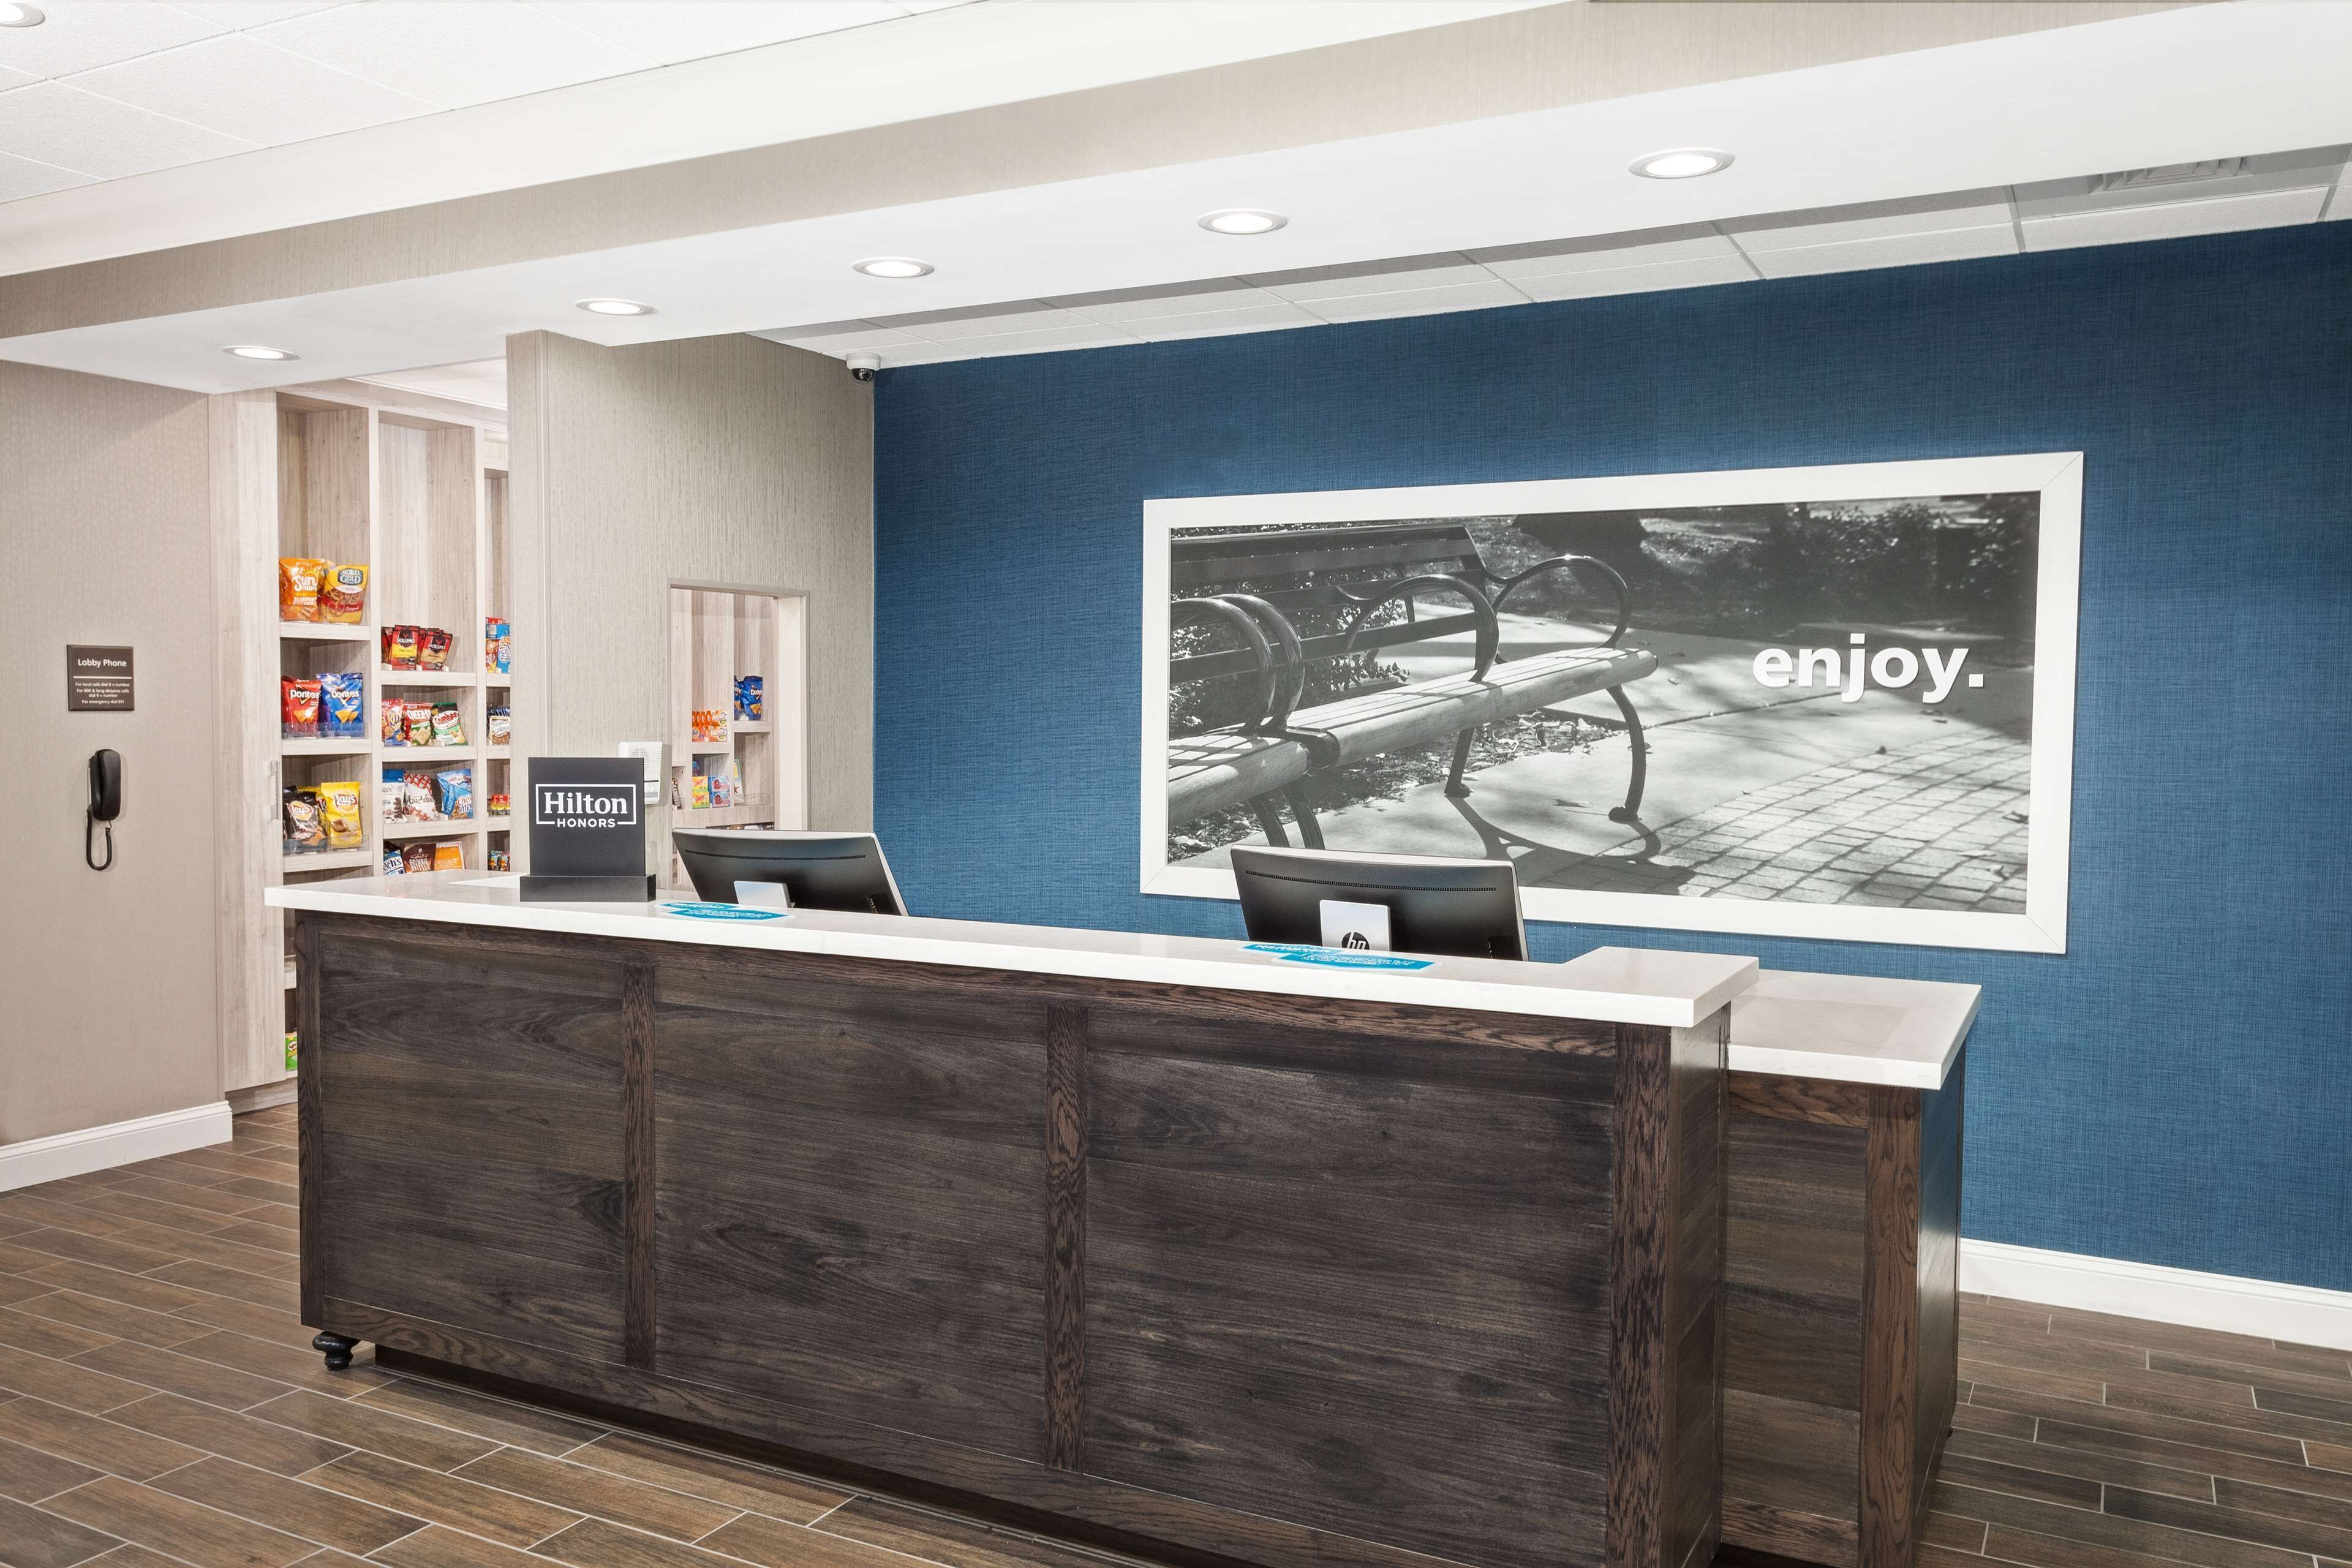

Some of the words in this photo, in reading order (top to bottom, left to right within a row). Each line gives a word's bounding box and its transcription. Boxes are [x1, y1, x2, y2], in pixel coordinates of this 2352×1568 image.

[292, 575, 318, 592] Sun
[78, 658, 101, 668] Lobby
[1753, 633, 1984, 704] enjoy.
[290, 690, 320, 699] Doritos
[437, 712, 459, 724] Combos
[335, 793, 356, 805] Lay's
[544, 792, 628, 815] Hilton
[291, 804, 311, 814] Lay's
[557, 818, 616, 828] HONORS
[383, 858, 402, 871] elch's
